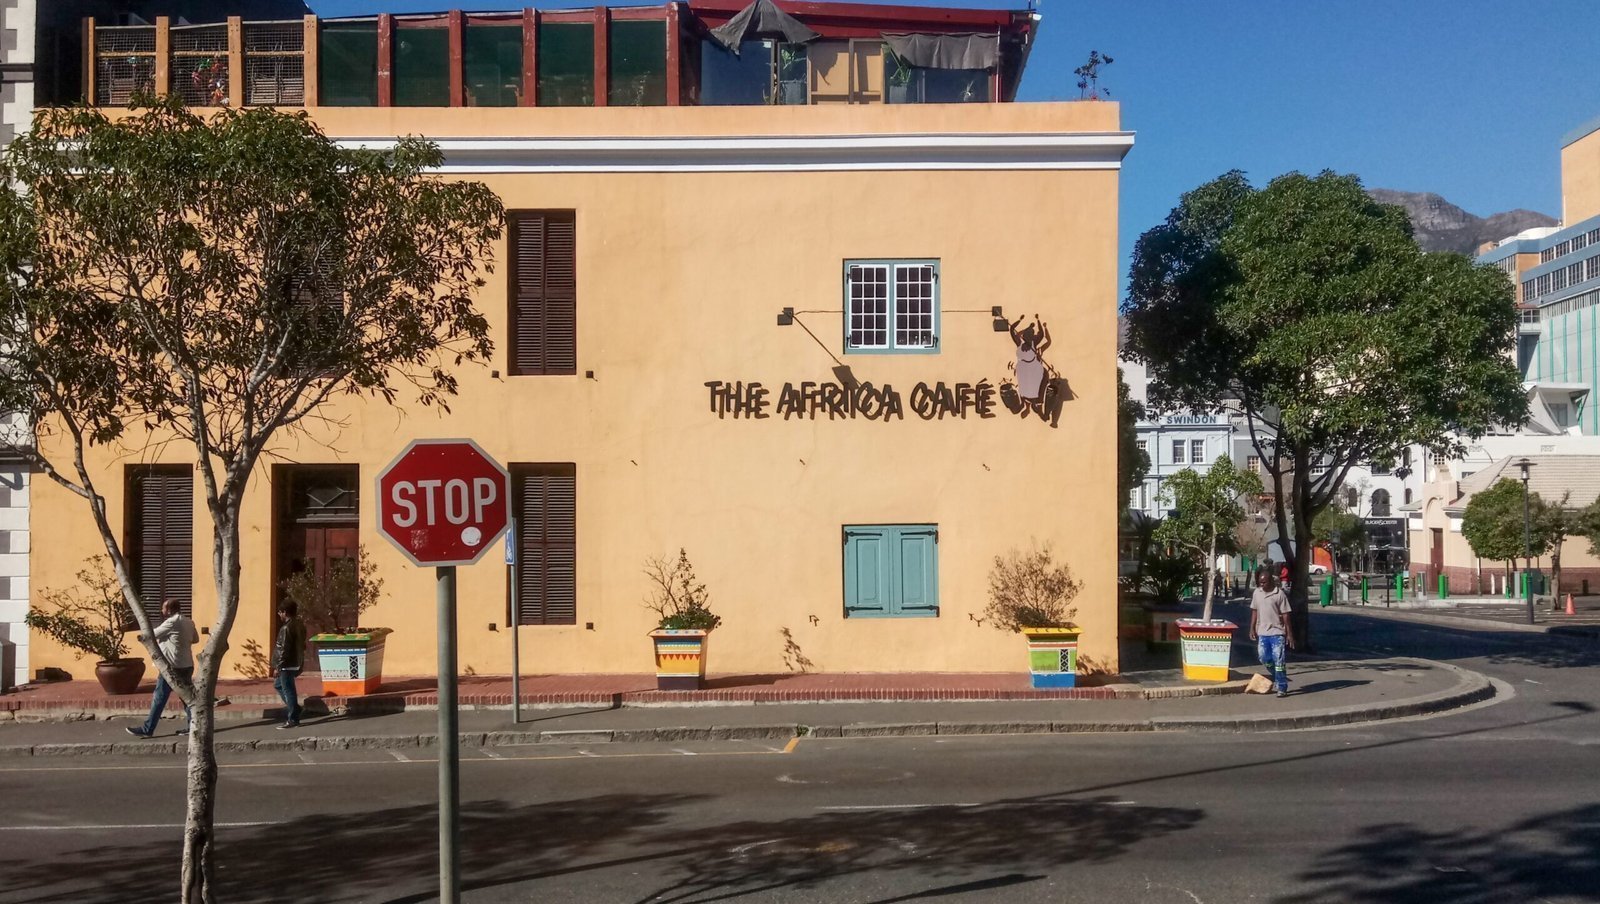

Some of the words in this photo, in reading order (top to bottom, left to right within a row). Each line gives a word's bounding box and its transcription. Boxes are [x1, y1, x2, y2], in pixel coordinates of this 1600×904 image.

[704, 380, 770, 419] THE
[776, 380, 904, 422] AFRICA
[910, 377, 997, 420] CAFÉ
[1166, 415, 1217, 425] SWINDON
[391, 477, 497, 528] STOP
